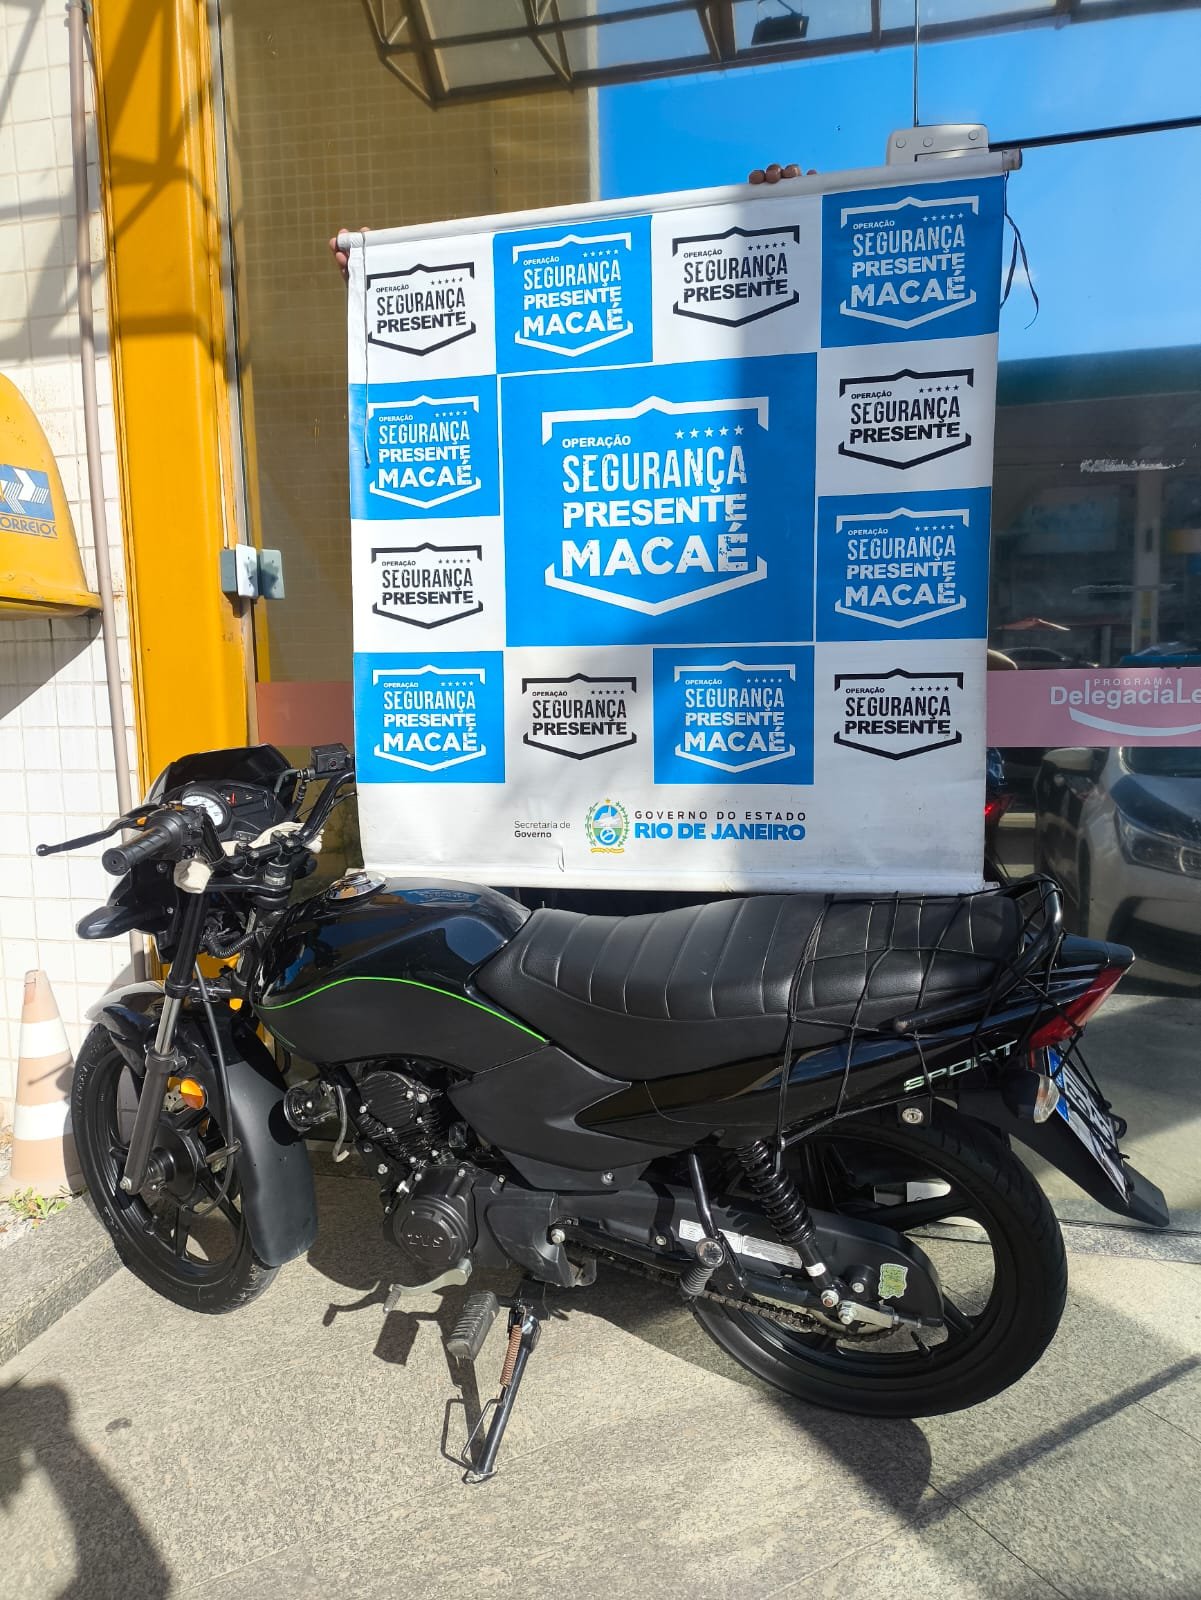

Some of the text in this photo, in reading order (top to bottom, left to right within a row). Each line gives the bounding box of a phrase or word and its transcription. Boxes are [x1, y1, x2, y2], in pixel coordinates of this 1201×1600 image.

[852, 219, 896, 230] OPERAÇÃO
[852, 223, 966, 257] SEGURANÇA
[522, 255, 560, 266] OPERAÇÃO
[683, 248, 723, 259] OPERAÇÃO
[522, 259, 622, 291] SEGURANÇA
[683, 252, 788, 284] SEGURANÇA
[851, 252, 966, 279] PRESENTE
[375, 283, 410, 293] OPERAÇÃO
[522, 285, 622, 311] PRESENTE
[683, 278, 788, 304] PRESENTE
[850, 269, 966, 308] MACAÉ
[376, 287, 466, 316] SEGURANÇA
[376, 311, 467, 334] PRESENTE
[522, 301, 624, 338] MACAÉ
[850, 390, 893, 400] OPERAÇÃO
[378, 413, 414, 422] OPERAÇÃO
[850, 395, 961, 425] SEGURANÇA
[378, 420, 470, 445] SEGURANÇA
[561, 434, 631, 449] OPERAÇÃO
[849, 421, 961, 444] PRESENTE
[378, 444, 471, 463] PRESENTE
[377, 460, 473, 490] MACAÉ
[561, 445, 748, 493] SEGURANÇA
[562, 493, 748, 530] PRESENTE
[847, 527, 889, 536] OPERAÇÃO
[561, 522, 749, 577] MACAÉ
[847, 535, 956, 561] SEGURANÇA
[381, 567, 473, 589] SEGURANÇA
[846, 560, 956, 580] PRESENTE
[381, 590, 474, 606] PRESENTE
[845, 578, 957, 608] MACAÉ
[383, 681, 419, 689] OPERAÇÃO
[685, 678, 723, 686] OPERAÇÃO
[845, 686, 886, 694] OPERAÇÃO
[1093, 676, 1173, 687] PROGRAMA
[383, 690, 476, 711] SEGURANÇA
[532, 690, 568, 698] OPERAÇÃO
[685, 687, 785, 711] SEGURANÇA
[532, 699, 627, 721] SEGURANÇA
[845, 695, 951, 720] SEGURANÇA
[383, 712, 477, 728] PRESENTE
[532, 721, 628, 738] PRESENTE
[685, 711, 785, 727] PRESENTE
[844, 719, 951, 735] PRESENTE
[383, 726, 478, 752] MACAÉ
[684, 724, 786, 753] MACAÉ
[513, 820, 571, 830] Secretaria de
[634, 810, 807, 821] GOVERNO DO ESTADO
[513, 830, 553, 839] Governo
[634, 823, 806, 840] RIO DE JANEIRO
